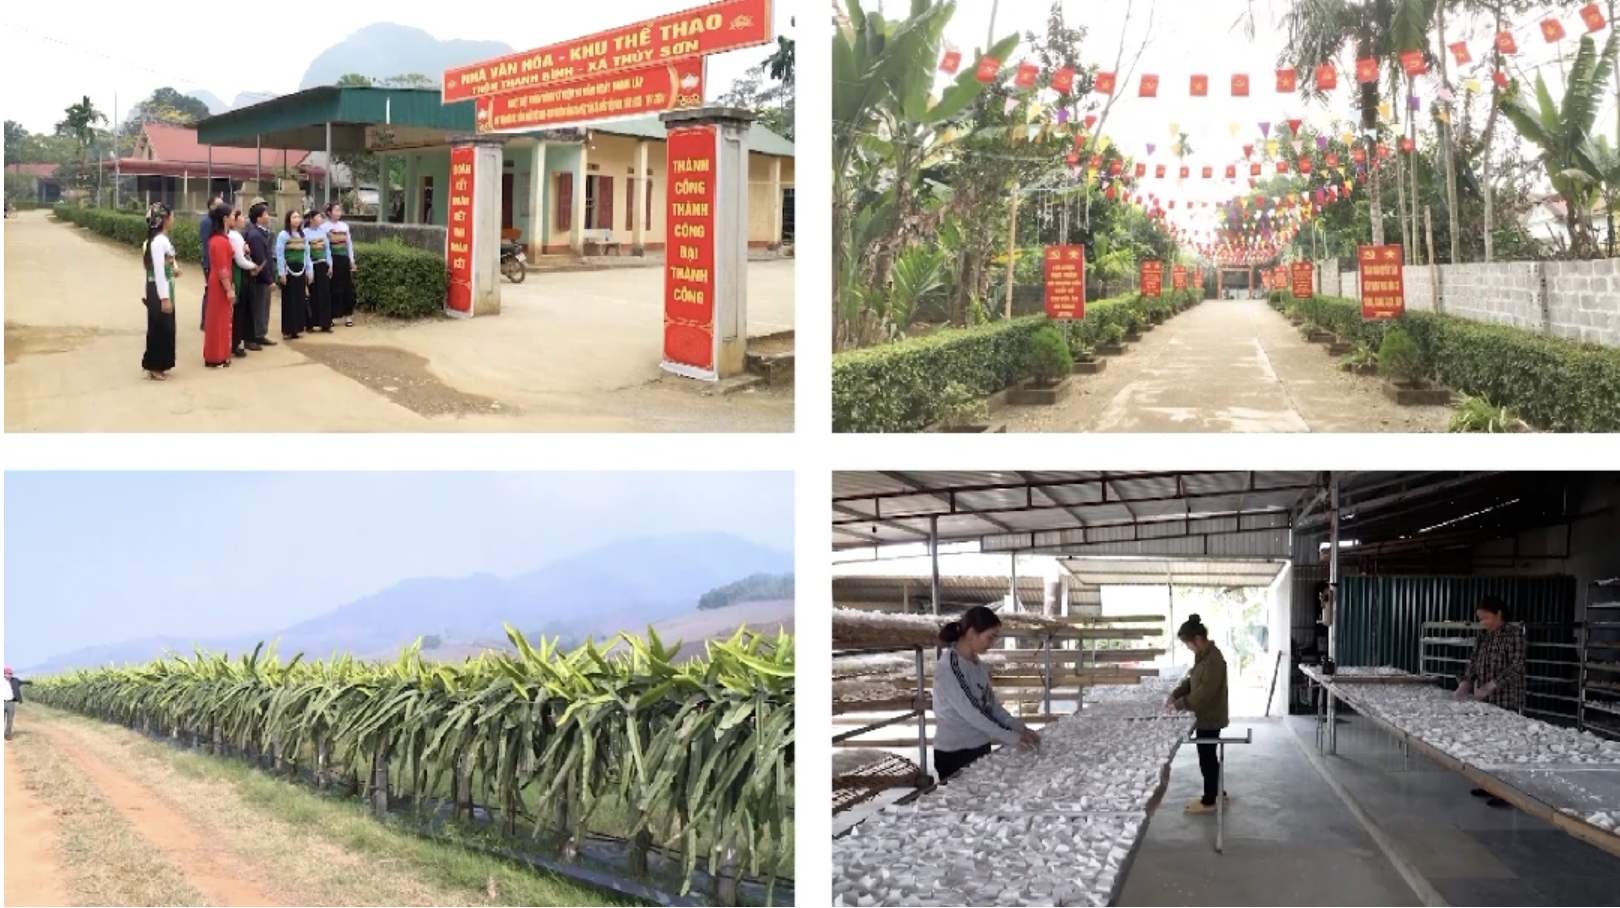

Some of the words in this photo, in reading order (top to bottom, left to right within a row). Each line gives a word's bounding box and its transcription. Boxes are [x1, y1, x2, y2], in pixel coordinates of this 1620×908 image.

[522, 54, 553, 72] HÓA
[570, 40, 607, 61] KHU
[614, 24, 653, 50] THỂ
[660, 13, 722, 41] THAO
[502, 74, 539, 88] THANH
[660, 40, 699, 57] SƠN
[673, 157, 709, 173] THÀNH
[675, 178, 705, 195] CÔNG
[672, 201, 709, 217] THÀNH
[674, 222, 705, 238] CÔNG
[670, 266, 708, 283] THÀNH
[673, 286, 704, 304] CÔNG
